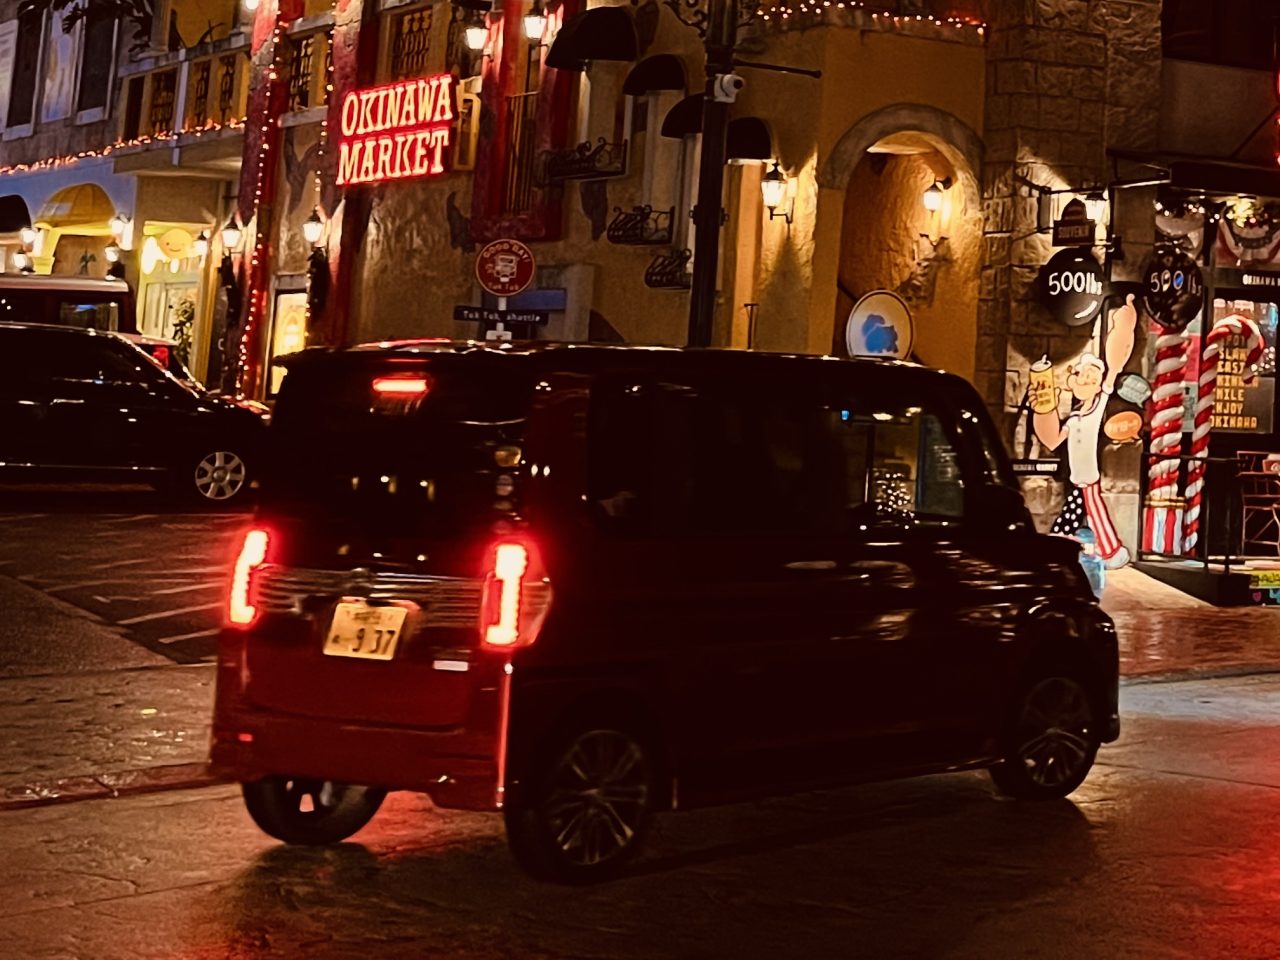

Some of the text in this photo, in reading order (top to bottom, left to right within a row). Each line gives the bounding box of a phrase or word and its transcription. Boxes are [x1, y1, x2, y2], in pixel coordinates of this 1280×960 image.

[341, 74, 453, 136] OKINAWA
[335, 127, 449, 185] MARKET
[483, 242, 510, 258] GOOD
